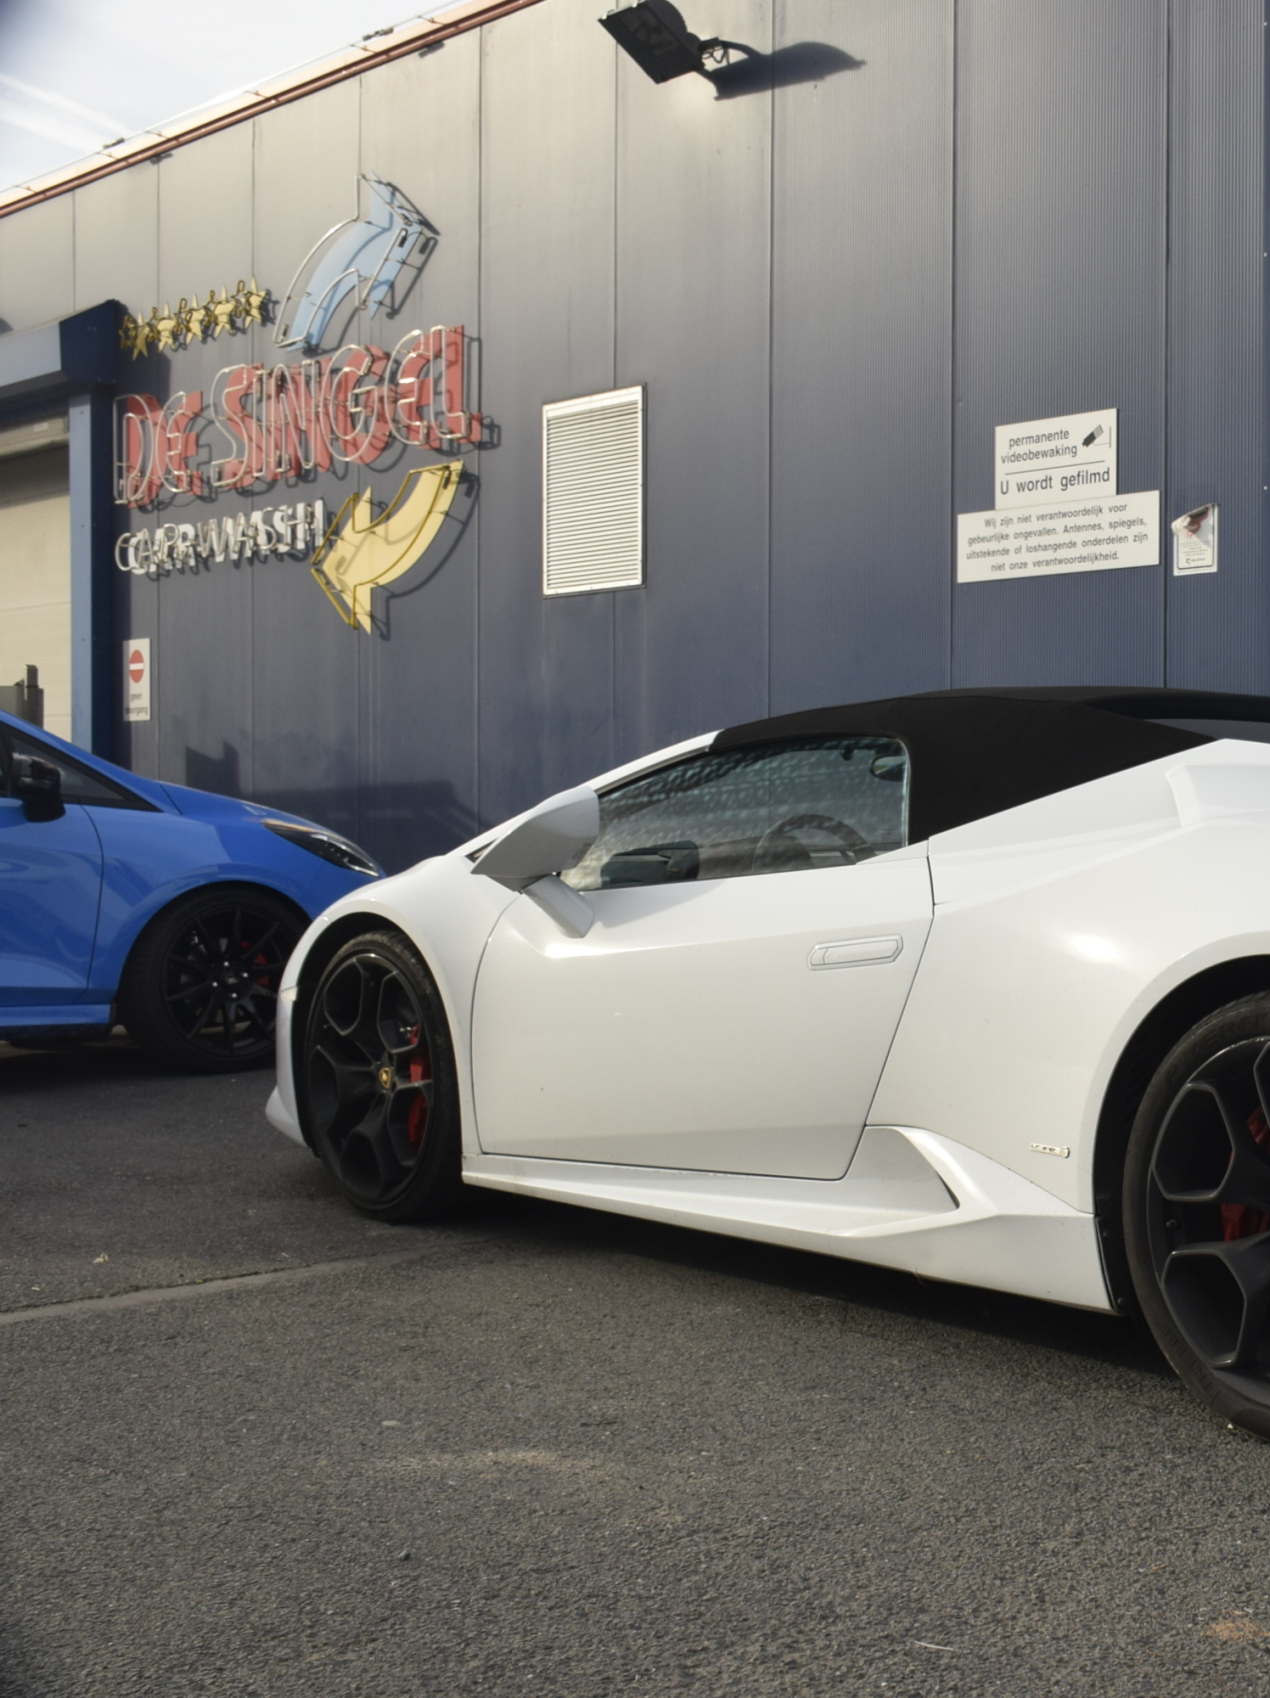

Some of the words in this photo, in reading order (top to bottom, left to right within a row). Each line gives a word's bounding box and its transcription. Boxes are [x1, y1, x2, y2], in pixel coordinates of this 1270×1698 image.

[1009, 429, 1069, 450] permanente
[1000, 445, 1078, 464] videobewaking
[1000, 480, 1010, 495] U
[1016, 475, 1053, 493] wordt
[1060, 467, 1110, 491] gefilmd
[984, 517, 997, 529] Wij
[1000, 516, 1014, 527] zijn
[1017, 514, 1032, 524] niet
[1036, 505, 1103, 523] verantwoordelijk
[1108, 503, 1128, 513] voor
[968, 533, 1010, 547] gebeurlijke
[1013, 528, 1059, 541] ongevallen.
[1062, 522, 1105, 534] Antennes,
[1108, 516, 1147, 530] spiegels,
[966, 548, 1011, 560] uitstekende
[1014, 545, 1022, 555] of
[1025, 540, 1078, 554] loshangende
[1081, 535, 1129, 548] onderdelen
[1132, 531, 1149, 544] zijn
[991, 562, 1006, 572] niet
[1009, 561, 1028, 571] onze
[1032, 551, 1120, 568] verantwoordelijkheid.
